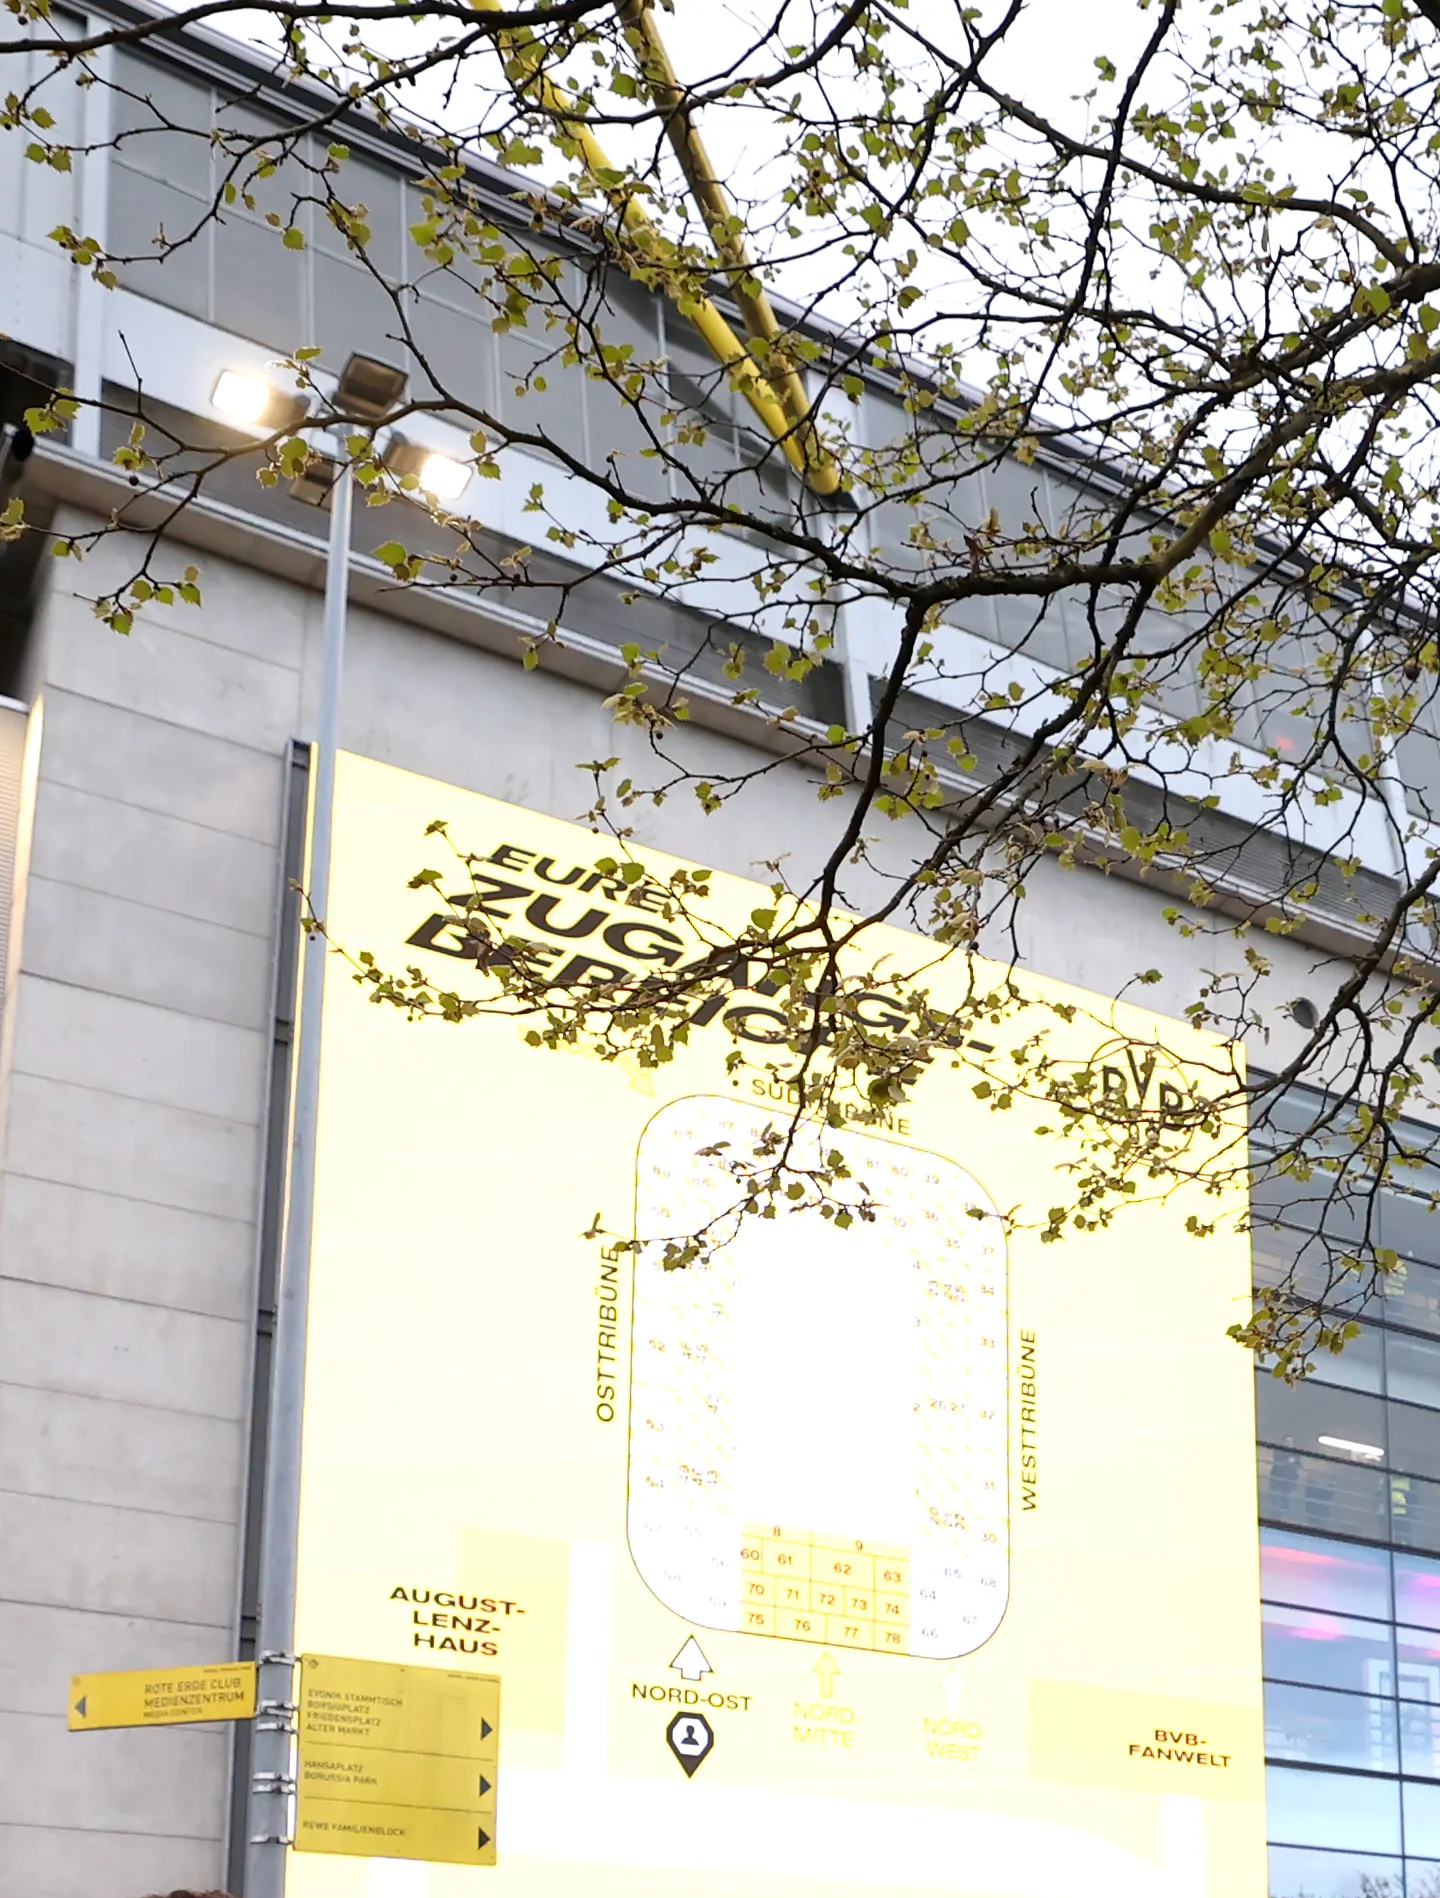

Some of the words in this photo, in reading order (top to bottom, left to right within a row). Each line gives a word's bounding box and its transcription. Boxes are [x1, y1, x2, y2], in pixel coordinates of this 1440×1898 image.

[490, 845, 678, 916] EURE
[595, 1247, 620, 1423] OSTTRIBÜNE
[1016, 1329, 1039, 1511] WESTTRIBÜNE
[772, 1527, 782, 1538] 8
[856, 1541, 864, 1552] 9
[740, 1549, 760, 1561] 60
[777, 1554, 794, 1566] 61
[834, 1563, 852, 1576] 62
[884, 1571, 901, 1583] 63
[390, 1586, 526, 1615] AUGUST-
[748, 1583, 765, 1596] 70
[786, 1588, 799, 1600] 71
[819, 1593, 836, 1606] 72
[851, 1598, 868, 1611] 73
[885, 1603, 900, 1615] 74
[413, 1610, 501, 1634] LENZ-
[748, 1613, 765, 1626] 75
[794, 1619, 811, 1632] 76
[844, 1627, 859, 1639] 77
[885, 1632, 901, 1645] 78
[413, 1632, 498, 1656] HAUS
[144, 1683, 173, 1694] ROTE
[177, 1680, 206, 1692] ERDE
[210, 1678, 241, 1689] CLUB
[631, 1682, 752, 1712] NORD-OST
[144, 1692, 244, 1708] MEDIENZENTRUM
[306, 1723, 335, 1733] ALTER
[337, 1726, 370, 1736] MARKT
[307, 1712, 381, 1727] FRIEDENSPLATZ
[1154, 1729, 1208, 1747] BVB-
[1129, 1745, 1231, 1769] FANWELT
